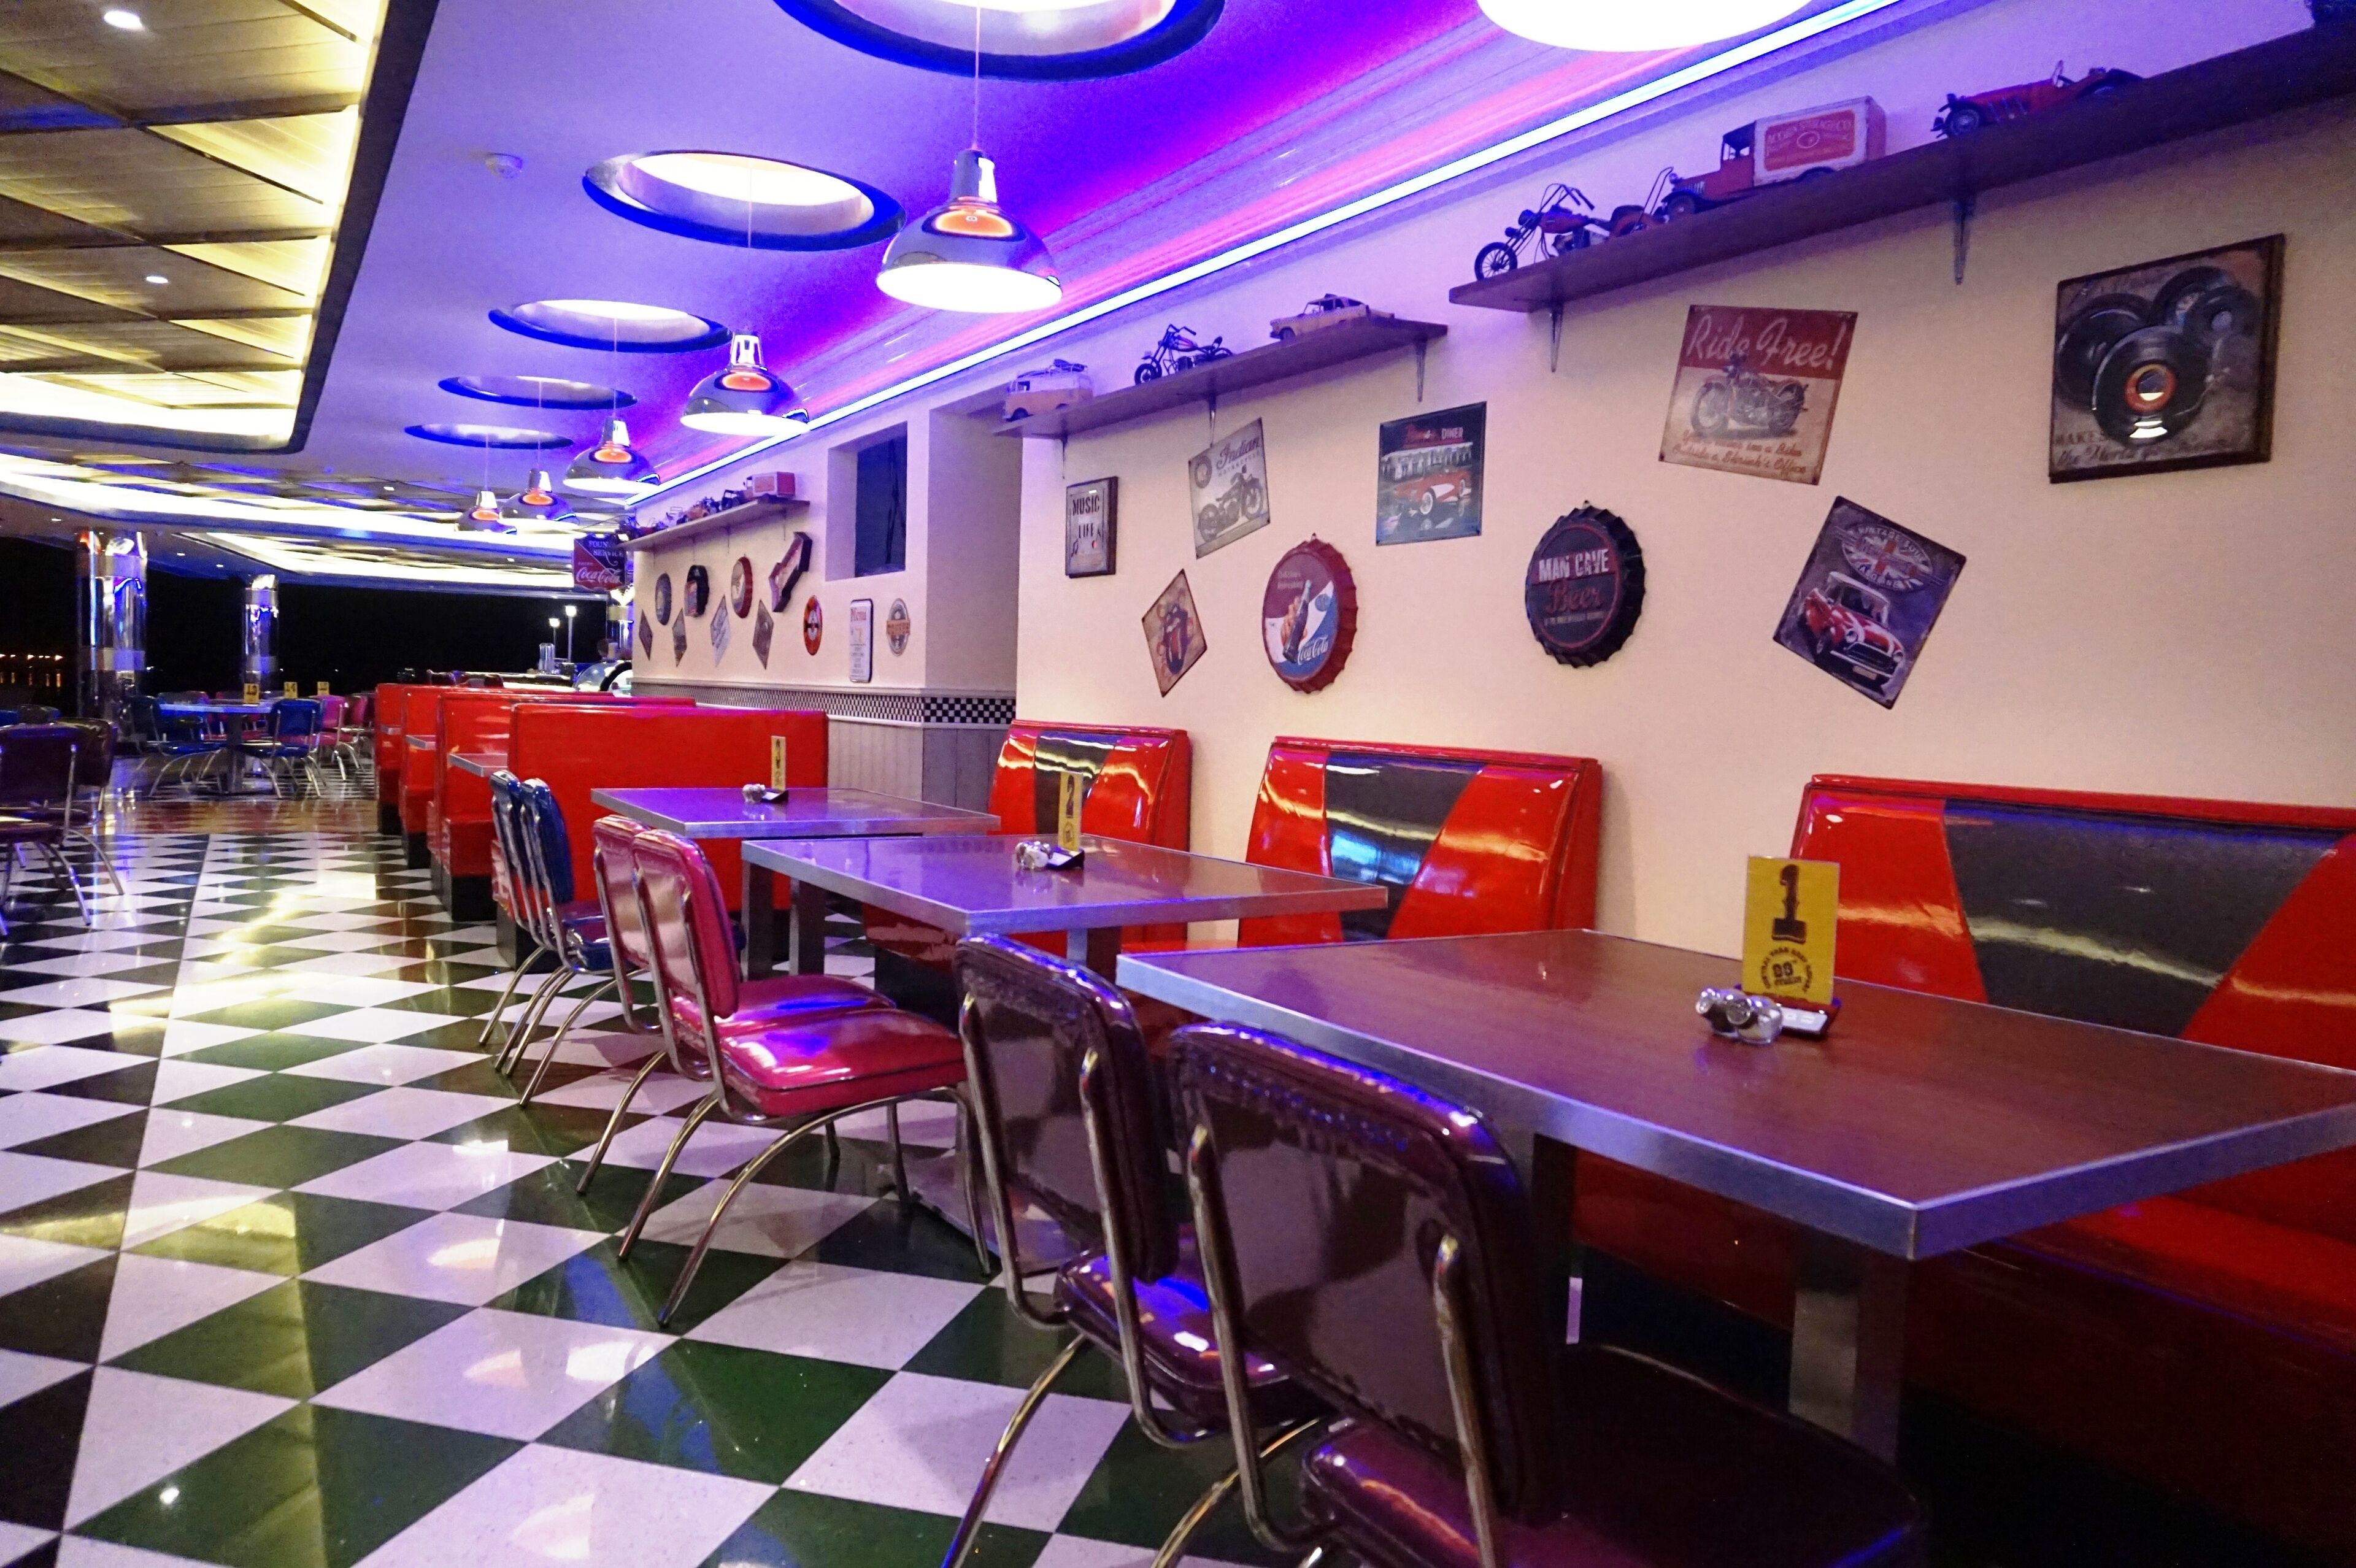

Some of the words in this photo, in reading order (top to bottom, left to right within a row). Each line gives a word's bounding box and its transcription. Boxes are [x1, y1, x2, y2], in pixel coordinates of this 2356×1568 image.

[1687, 313, 1750, 359] Ride
[1755, 317, 1847, 371] Free!
[1441, 427, 1463, 440] DINER
[1215, 437, 1260, 471] Indian
[1072, 494, 1100, 517] MUSIC
[1078, 523, 1094, 539] LIFE
[1538, 555, 1571, 582] MAN
[1574, 548, 1609, 577] CAVE
[1065, 774, 1076, 819] 2
[1771, 864, 1807, 945] 1
